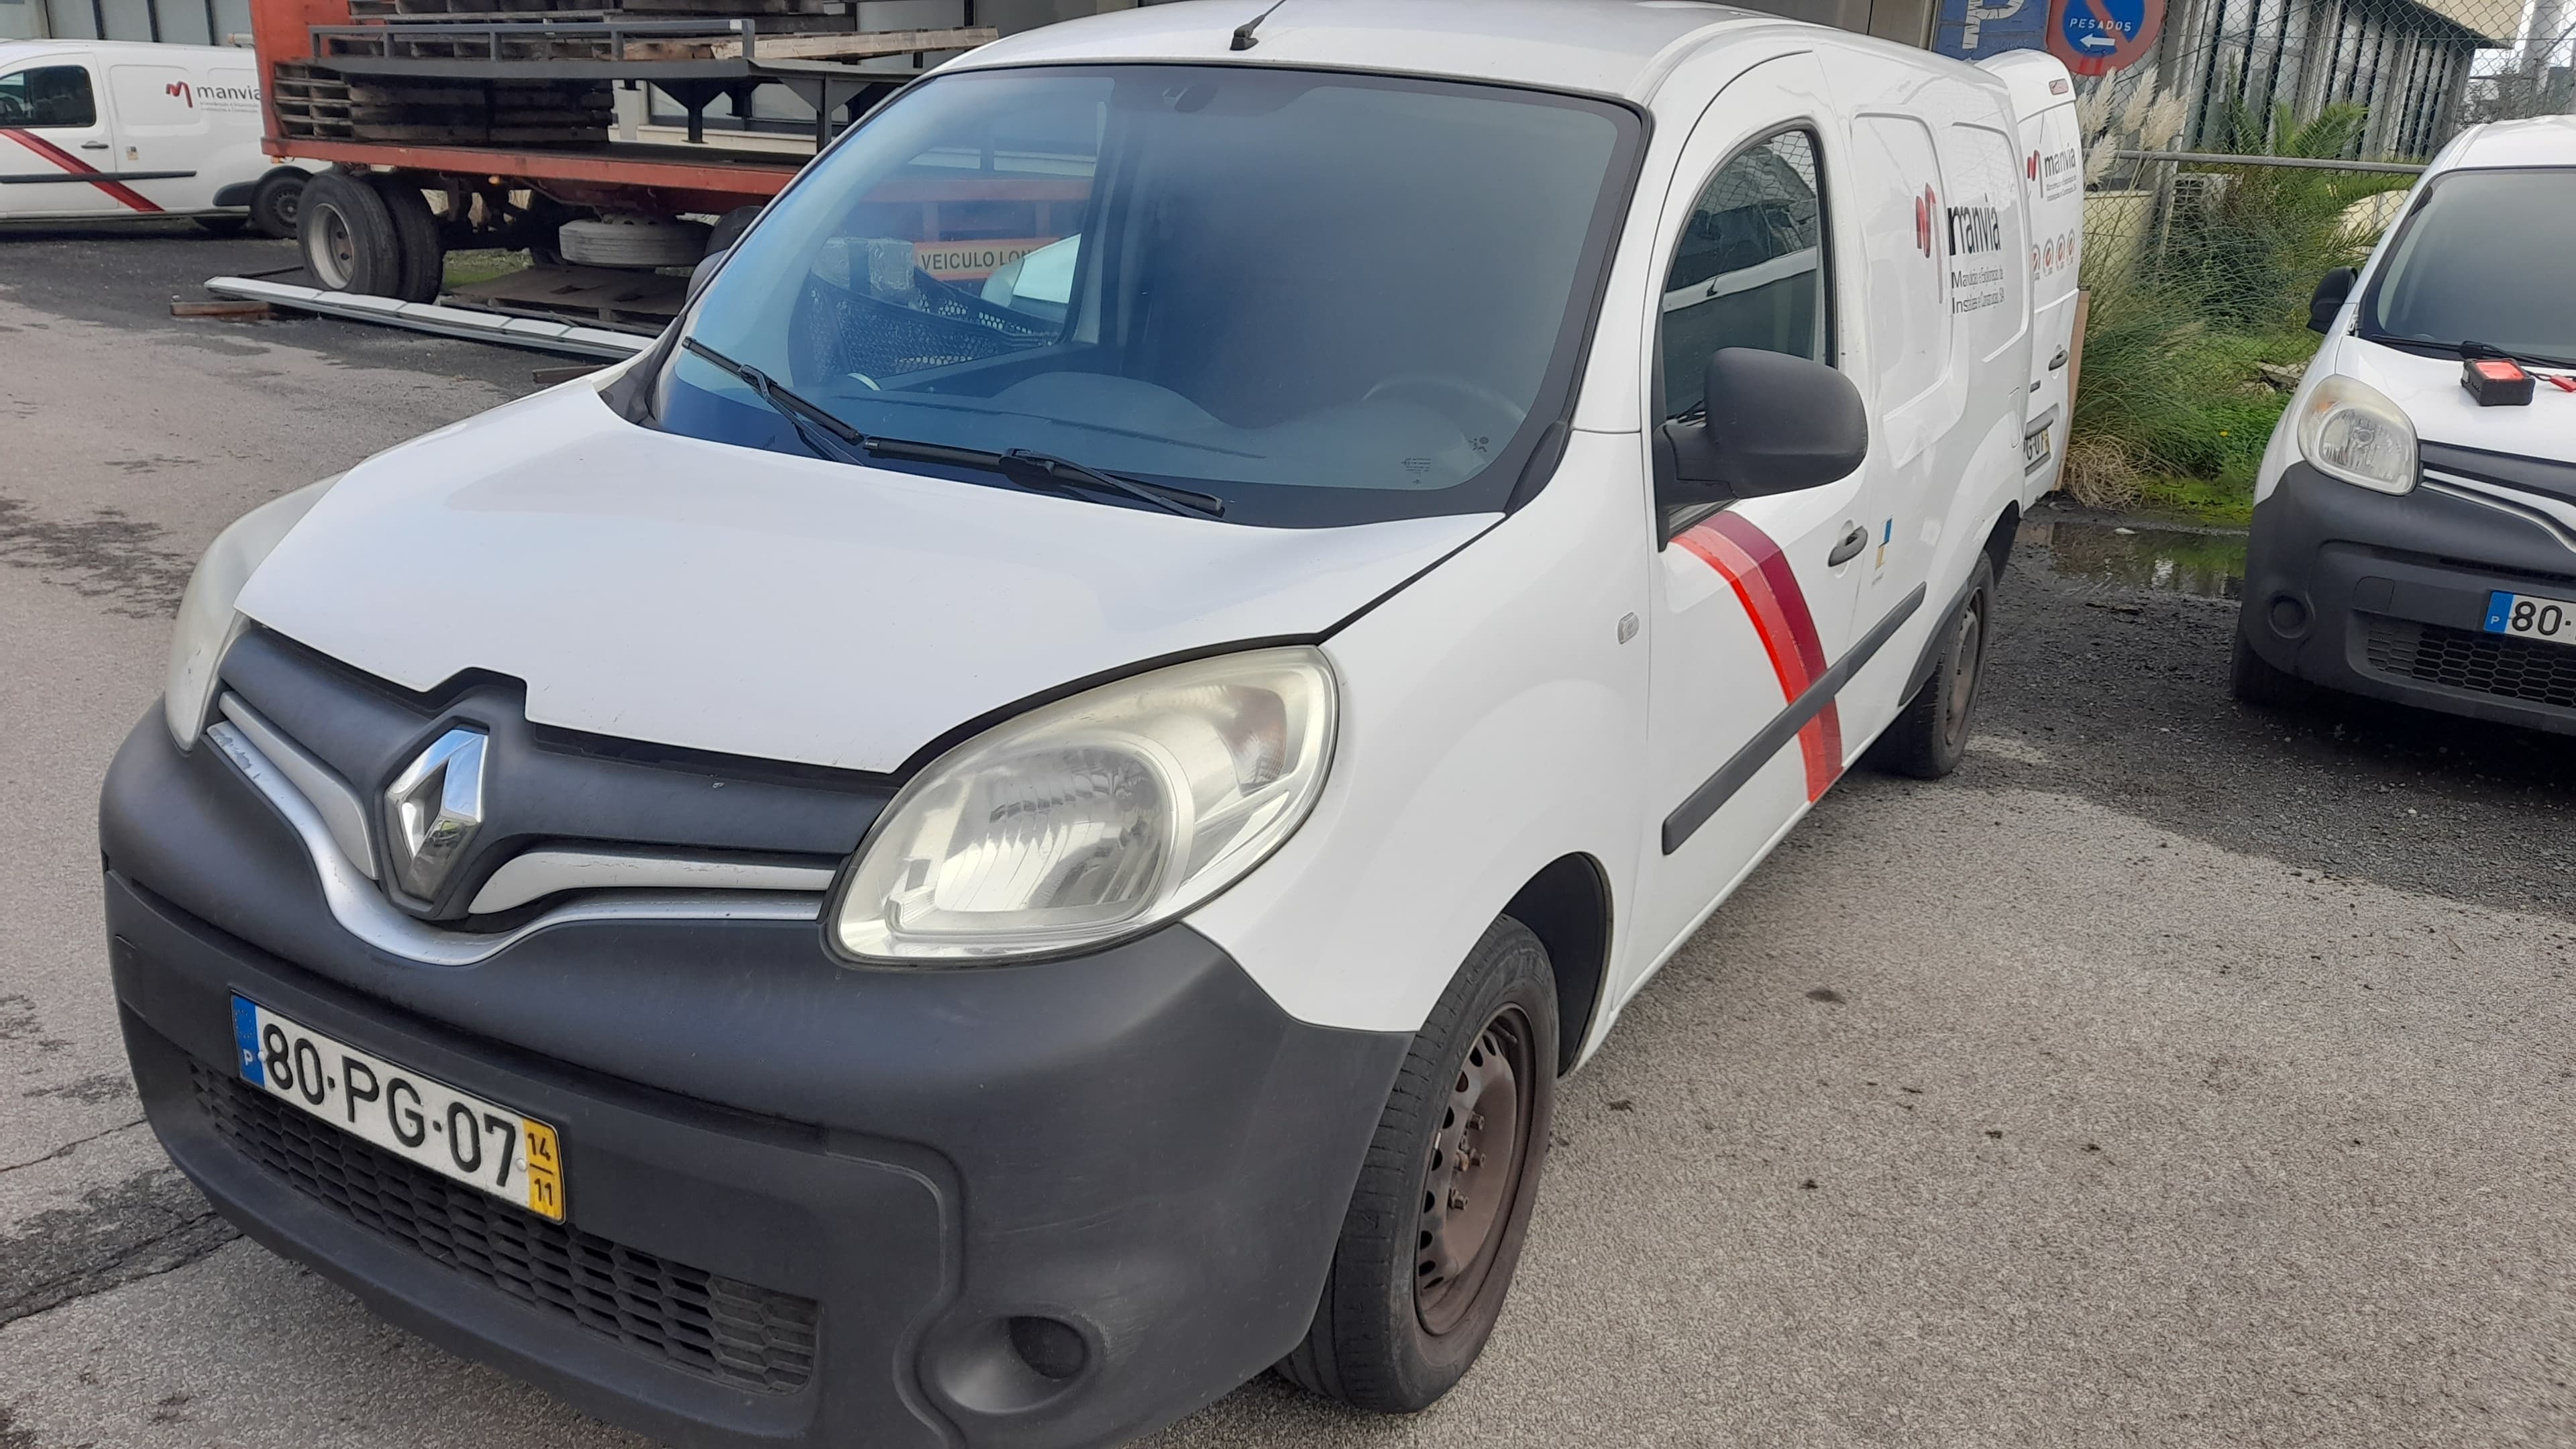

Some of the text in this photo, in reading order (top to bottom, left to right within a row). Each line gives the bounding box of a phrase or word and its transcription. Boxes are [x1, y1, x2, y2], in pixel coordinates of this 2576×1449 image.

[2070, 18, 2131, 32] PESADOS
[2045, 142, 2076, 177] manvia
[922, 251, 994, 270] VEICULO
[2490, 615, 2500, 624] P
[243, 1049, 253, 1066] P
[527, 1132, 551, 1161] 14
[534, 1178, 553, 1207] 11
